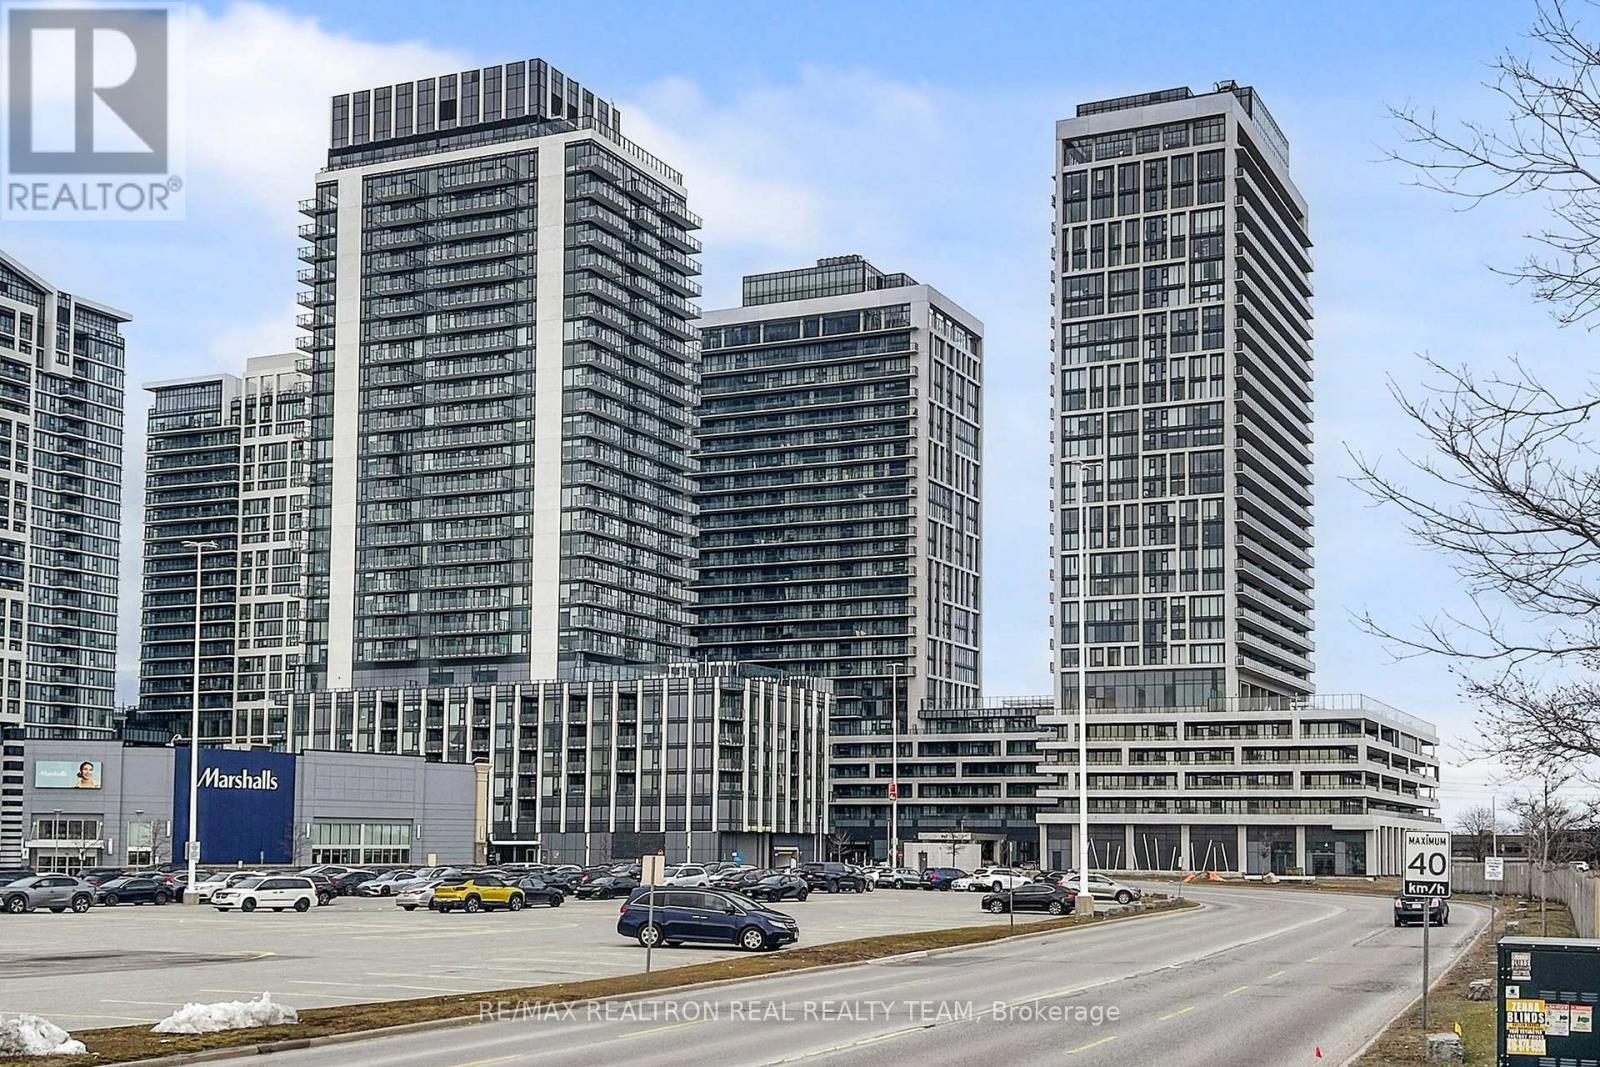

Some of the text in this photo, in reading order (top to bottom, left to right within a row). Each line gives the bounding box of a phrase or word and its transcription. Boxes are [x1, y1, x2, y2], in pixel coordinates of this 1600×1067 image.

[197, 767, 278, 791] Marshalls
[1408, 834, 1447, 846] MAXIMUM
[1407, 852, 1447, 876] 40
[1408, 882, 1445, 895] km/h
[1507, 1011, 1545, 1023] BLINDS
